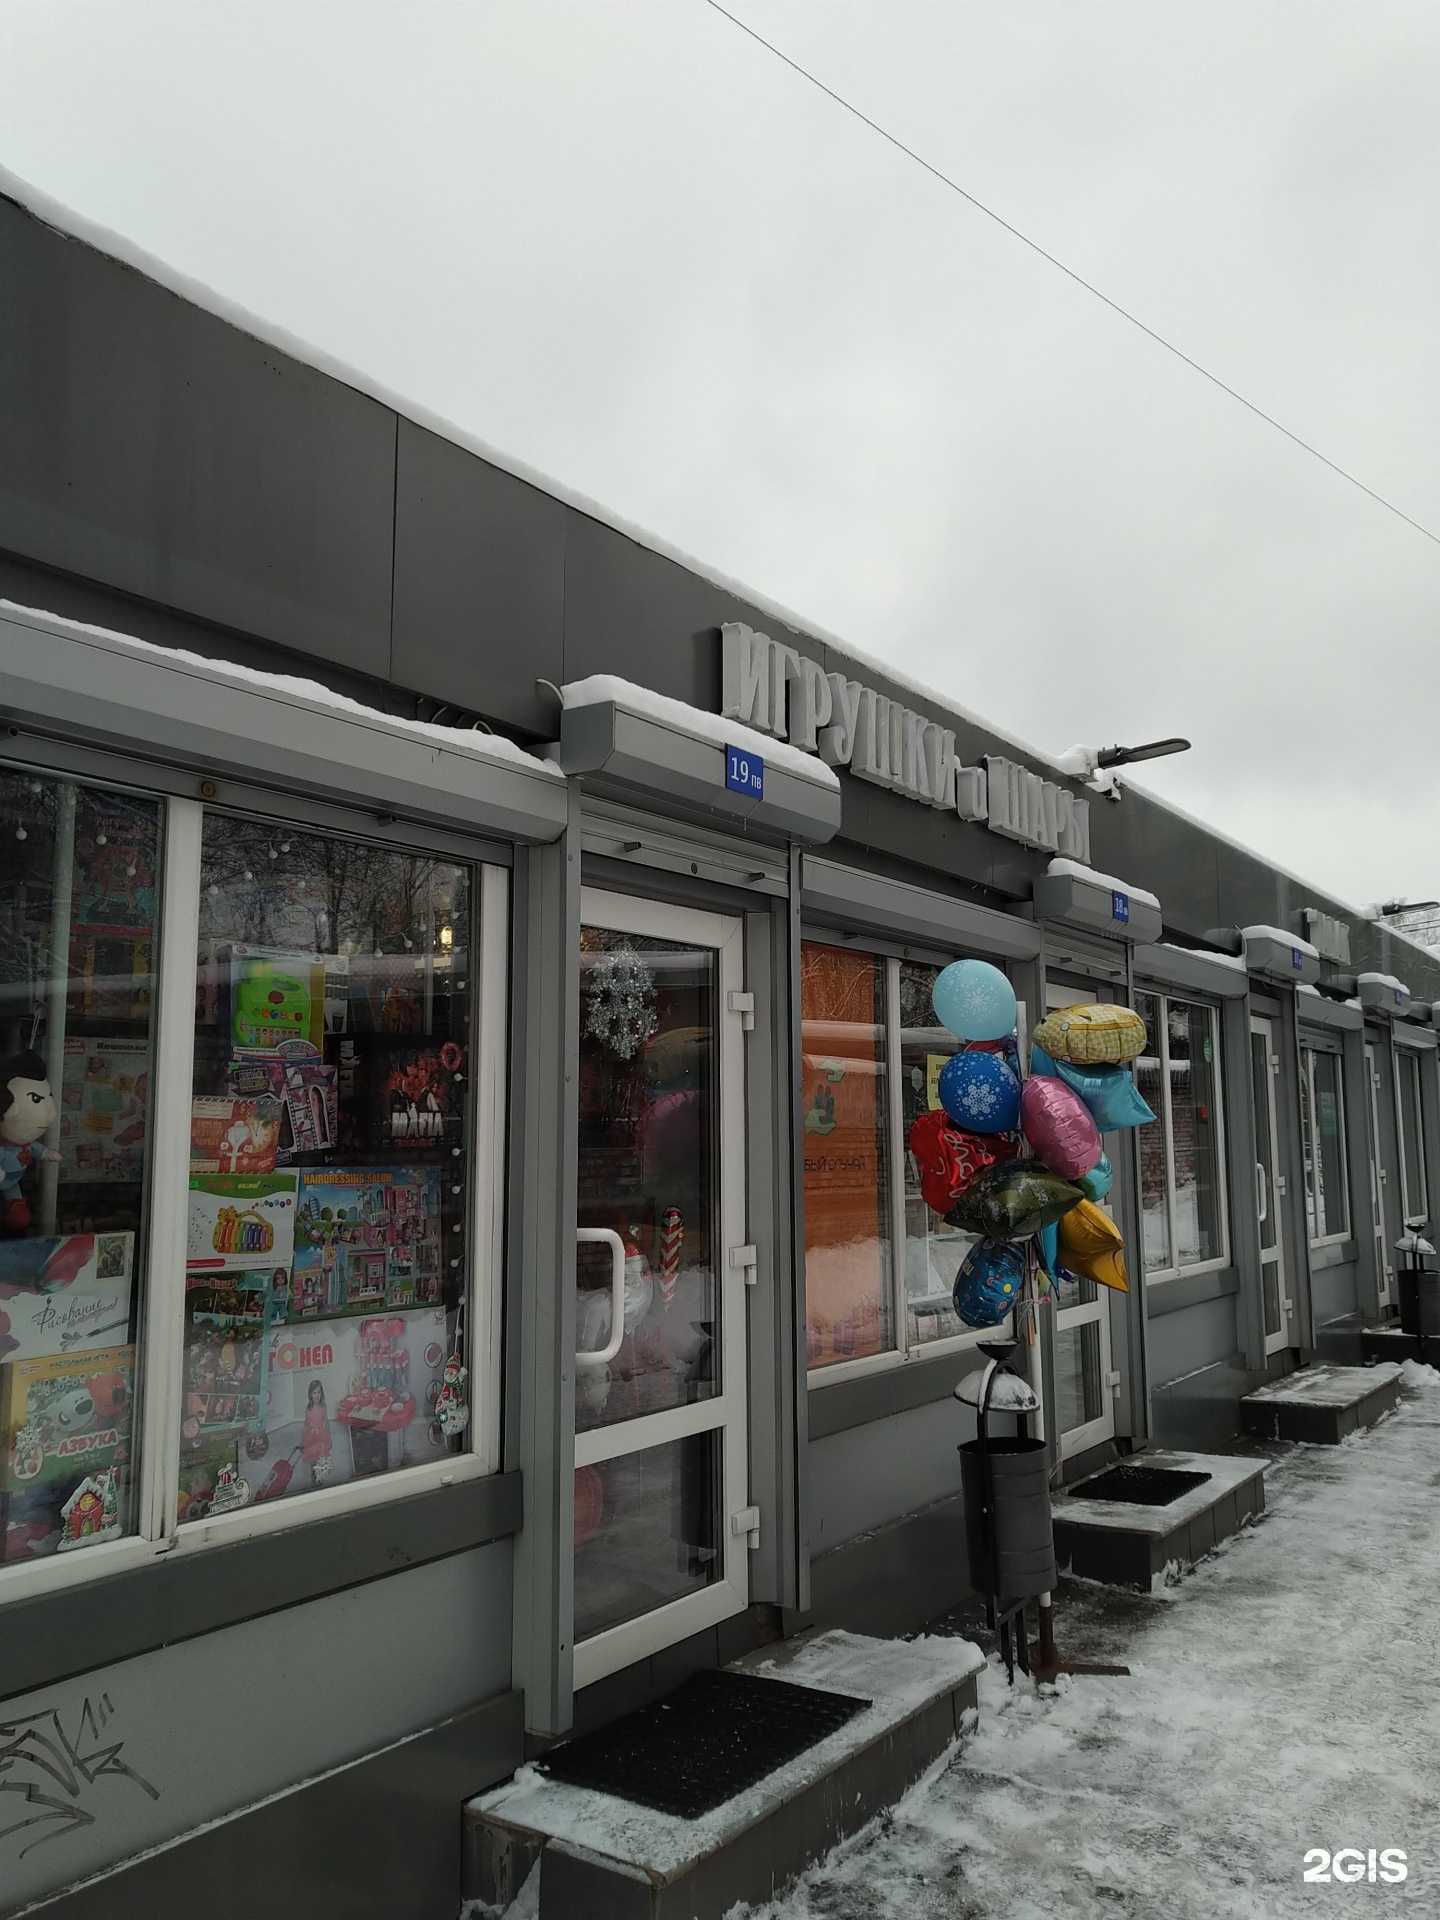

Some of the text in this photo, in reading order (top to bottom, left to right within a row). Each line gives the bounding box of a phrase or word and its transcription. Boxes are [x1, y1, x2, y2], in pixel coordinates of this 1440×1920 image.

[720, 622, 959, 810] ИГРУШКИ
[731, 757, 762, 790] 19 пв
[58, 1430, 118, 1457] АЗБУКА
